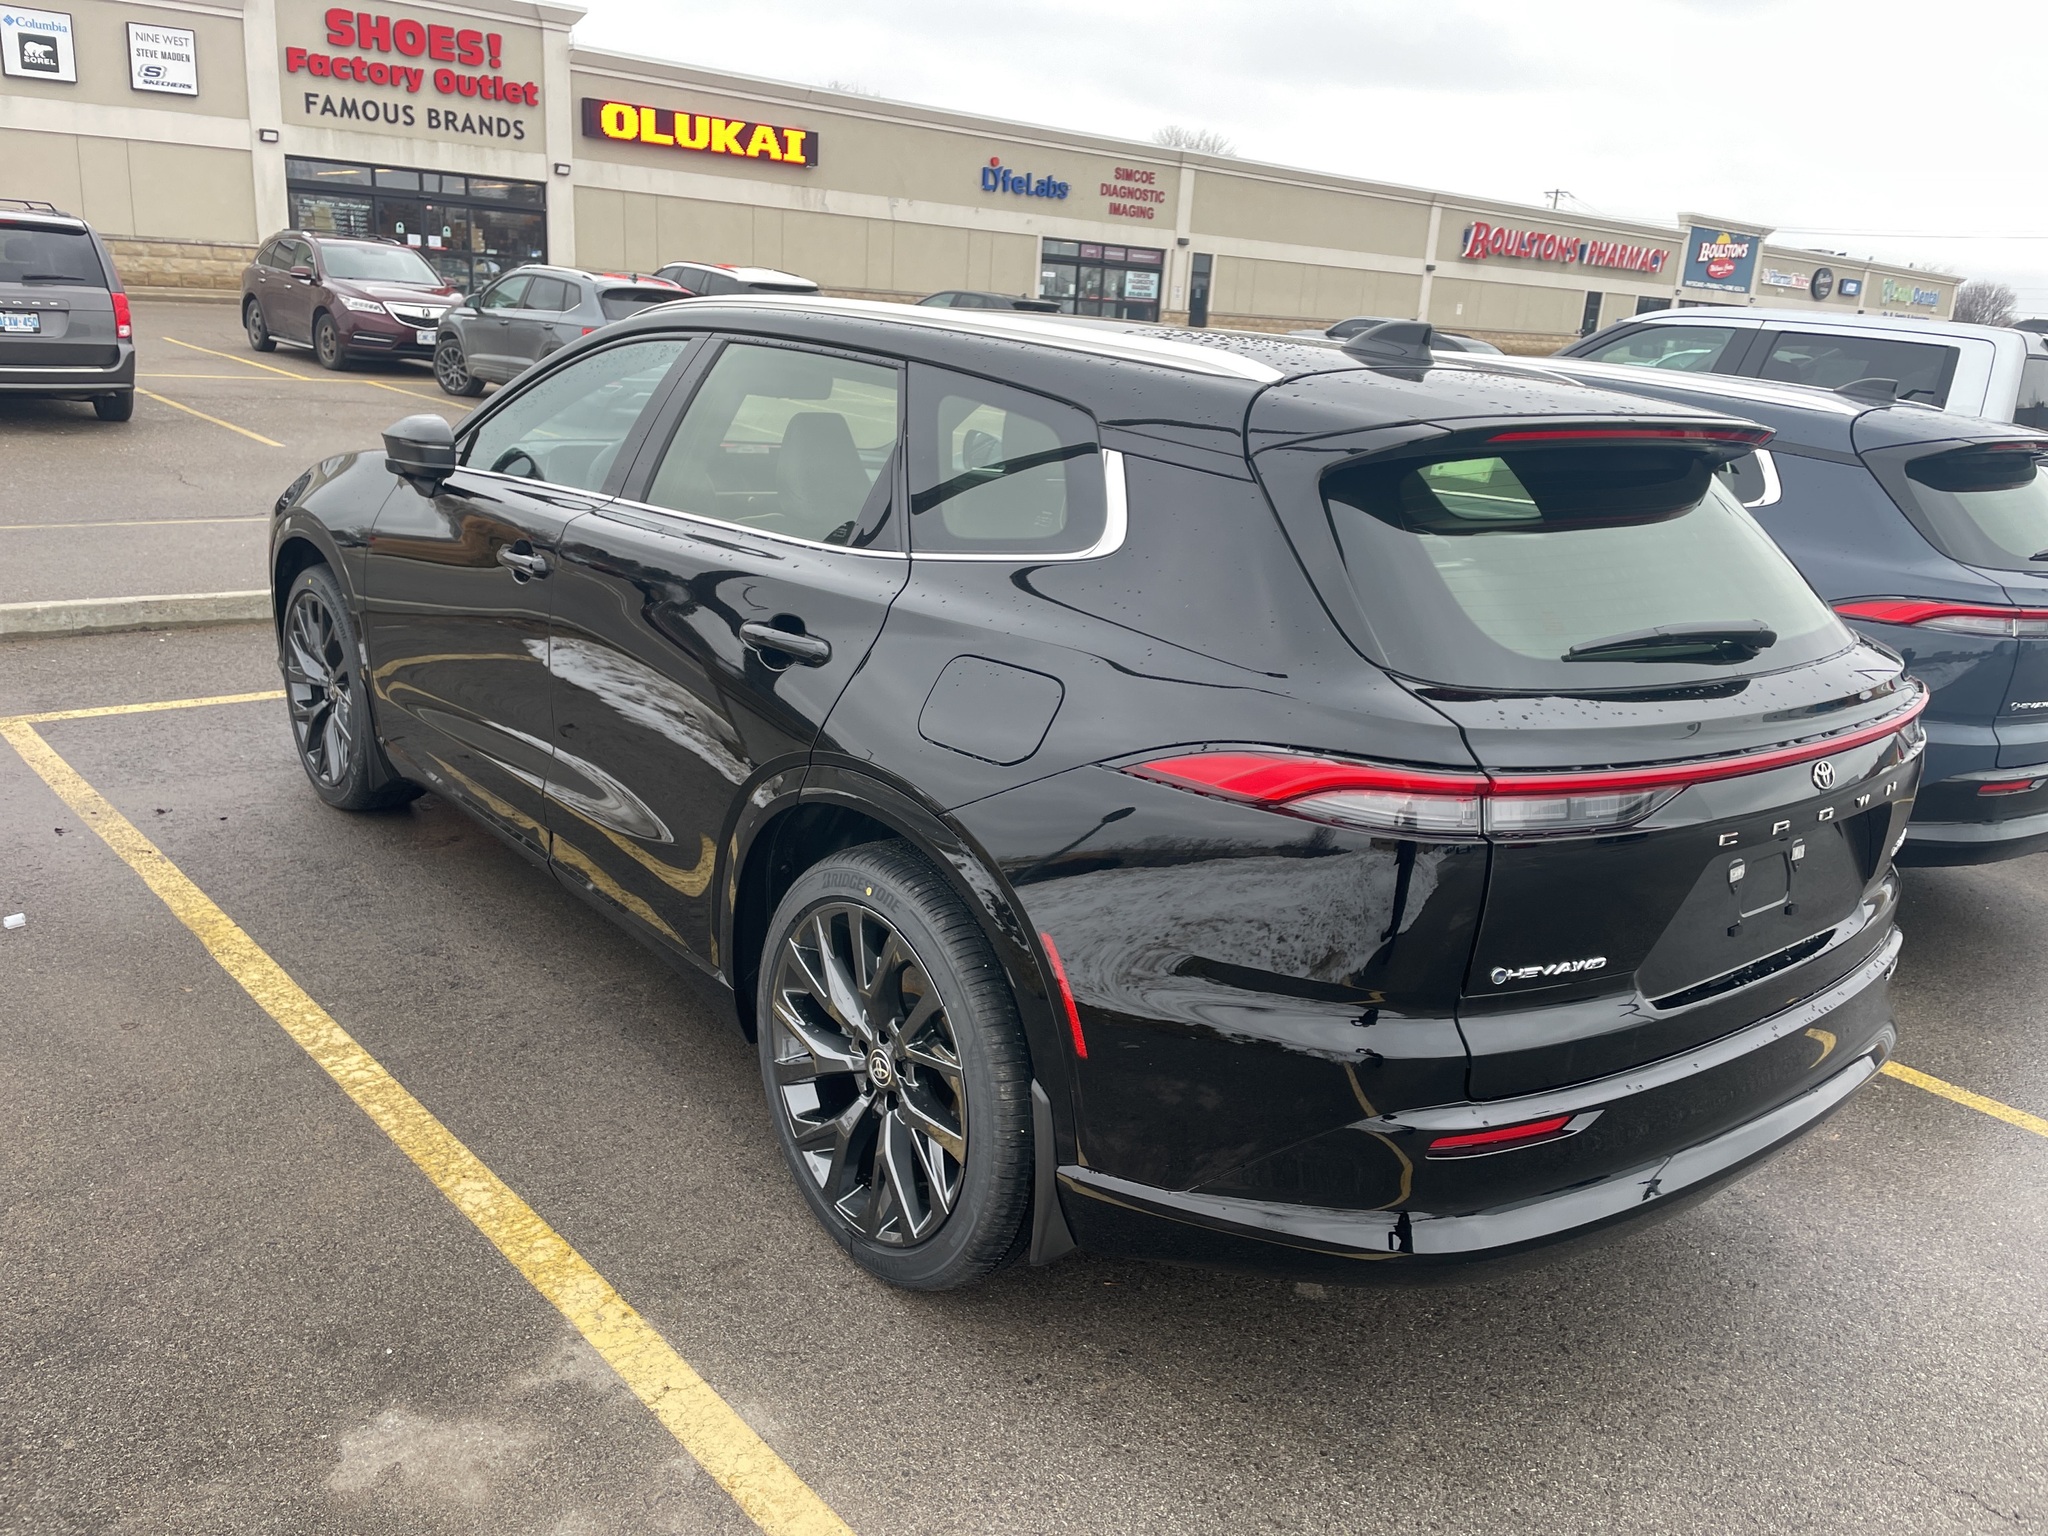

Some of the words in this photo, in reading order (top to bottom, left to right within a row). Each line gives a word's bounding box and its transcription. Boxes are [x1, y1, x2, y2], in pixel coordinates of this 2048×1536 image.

[15, 16, 68, 33] Columbia
[135, 31, 160, 44] NINE
[162, 35, 190, 47] WEST
[325, 8, 502, 69] SHOES!
[23, 55, 57, 66] SOREL
[136, 48, 158, 60] STEVE
[160, 51, 191, 63] MADDEN
[142, 78, 192, 90] SKECHERS
[286, 46, 425, 93] Factory
[434, 68, 539, 107] Outlet
[304, 92, 415, 127] FAMOUS
[427, 108, 525, 140] BRANDS
[600, 101, 806, 164] OLUKAI
[1114, 166, 1156, 185] SIMCOE
[1100, 183, 1165, 204] DIAGNOSTIC
[1108, 202, 1155, 220] IMAGING
[1583, 240, 1671, 273] PHARMACY
[1719, 781, 1897, 848] CROWN
[822, 872, 902, 915] BRIDGESTONE
